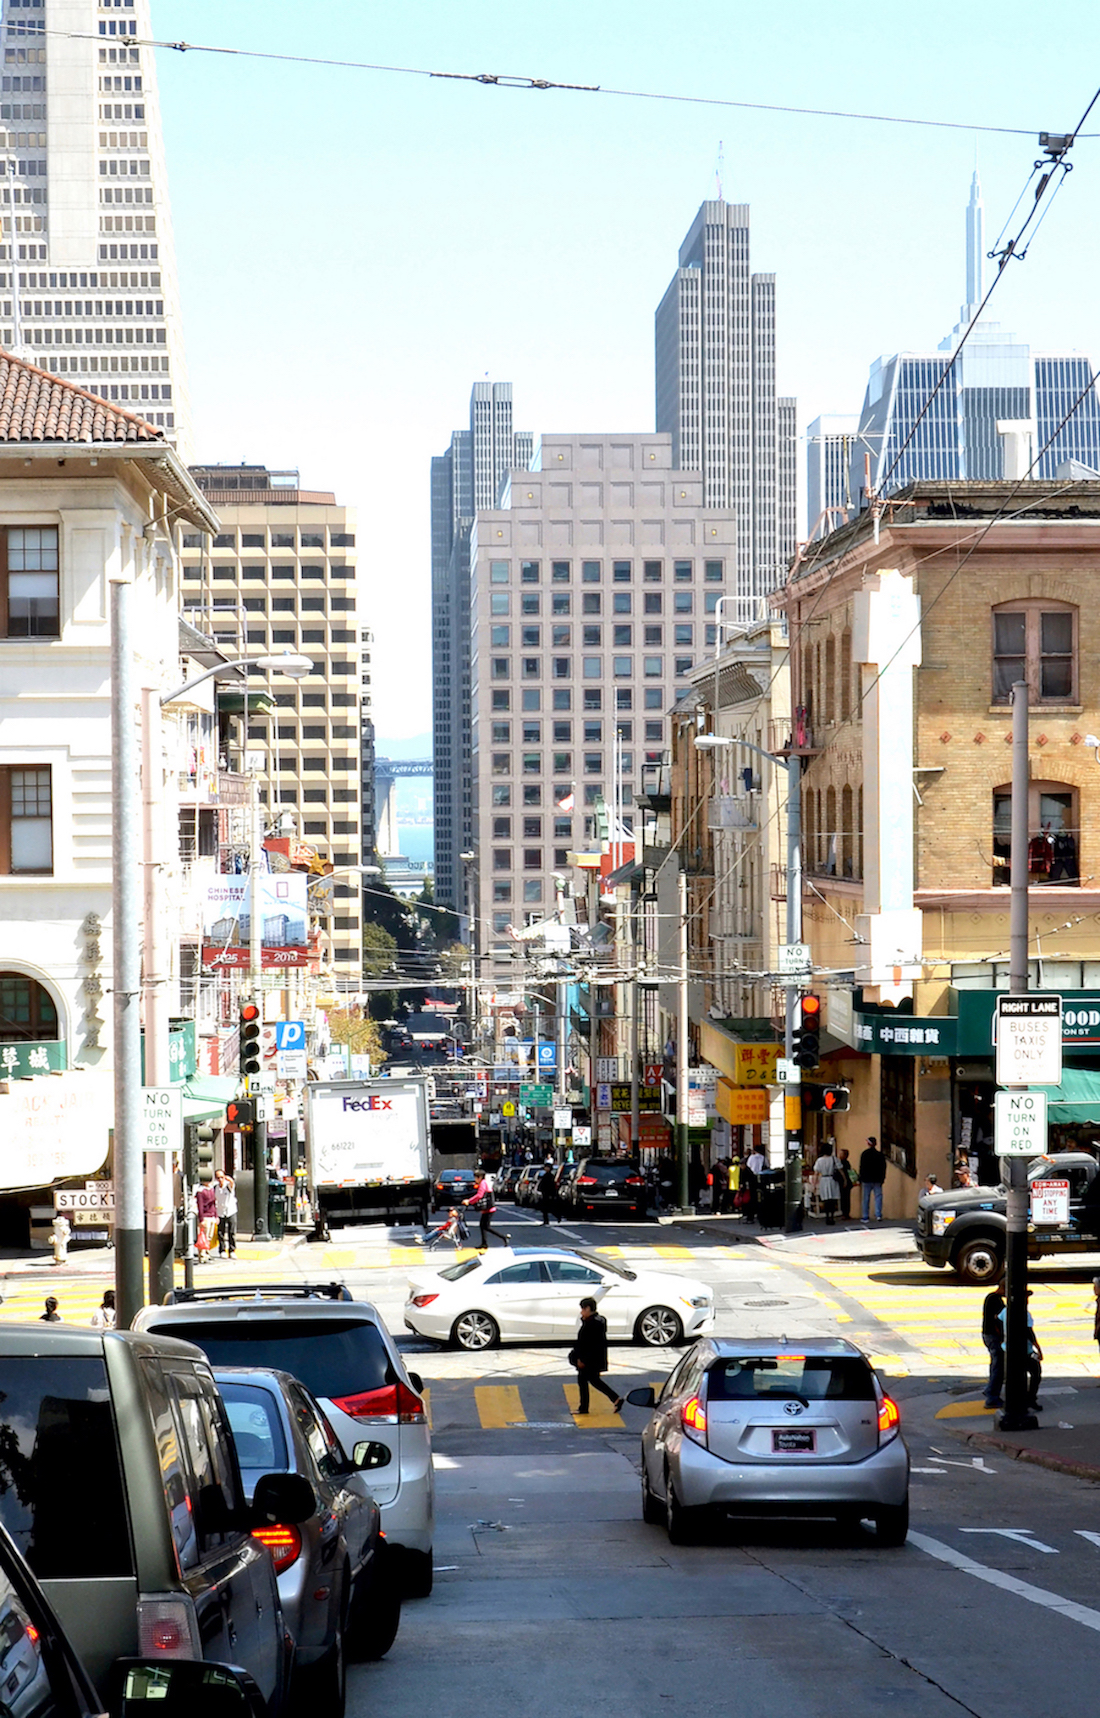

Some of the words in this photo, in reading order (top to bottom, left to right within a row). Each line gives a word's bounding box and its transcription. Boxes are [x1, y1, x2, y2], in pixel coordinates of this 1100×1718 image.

[787, 947, 802, 956] NO
[214, 953, 238, 962] 125
[1001, 1002, 1029, 1013] RIGHT
[1031, 1002, 1058, 1013] LANE
[1010, 1021, 1049, 1032] BUSES
[1014, 1035, 1046, 1046] TAXIS
[1014, 1049, 1044, 1060] ONLY
[746, 1069, 757, 1080] D
[147, 1093, 169, 1105] NO
[342, 1095, 393, 1112] FedEx
[1010, 1098, 1034, 1109] NO
[143, 1109, 171, 1118] TURN
[1008, 1113, 1036, 1122] TURN
[149, 1122, 165, 1132] ON
[1014, 1127, 1029, 1136] ON
[147, 1135, 168, 1145] RED
[1011, 1139, 1032, 1149] RED
[331, 1141, 355, 1151] 661221
[1032, 1189, 1043, 1198] NO
[778, 1434, 810, 1442] AutoNation
